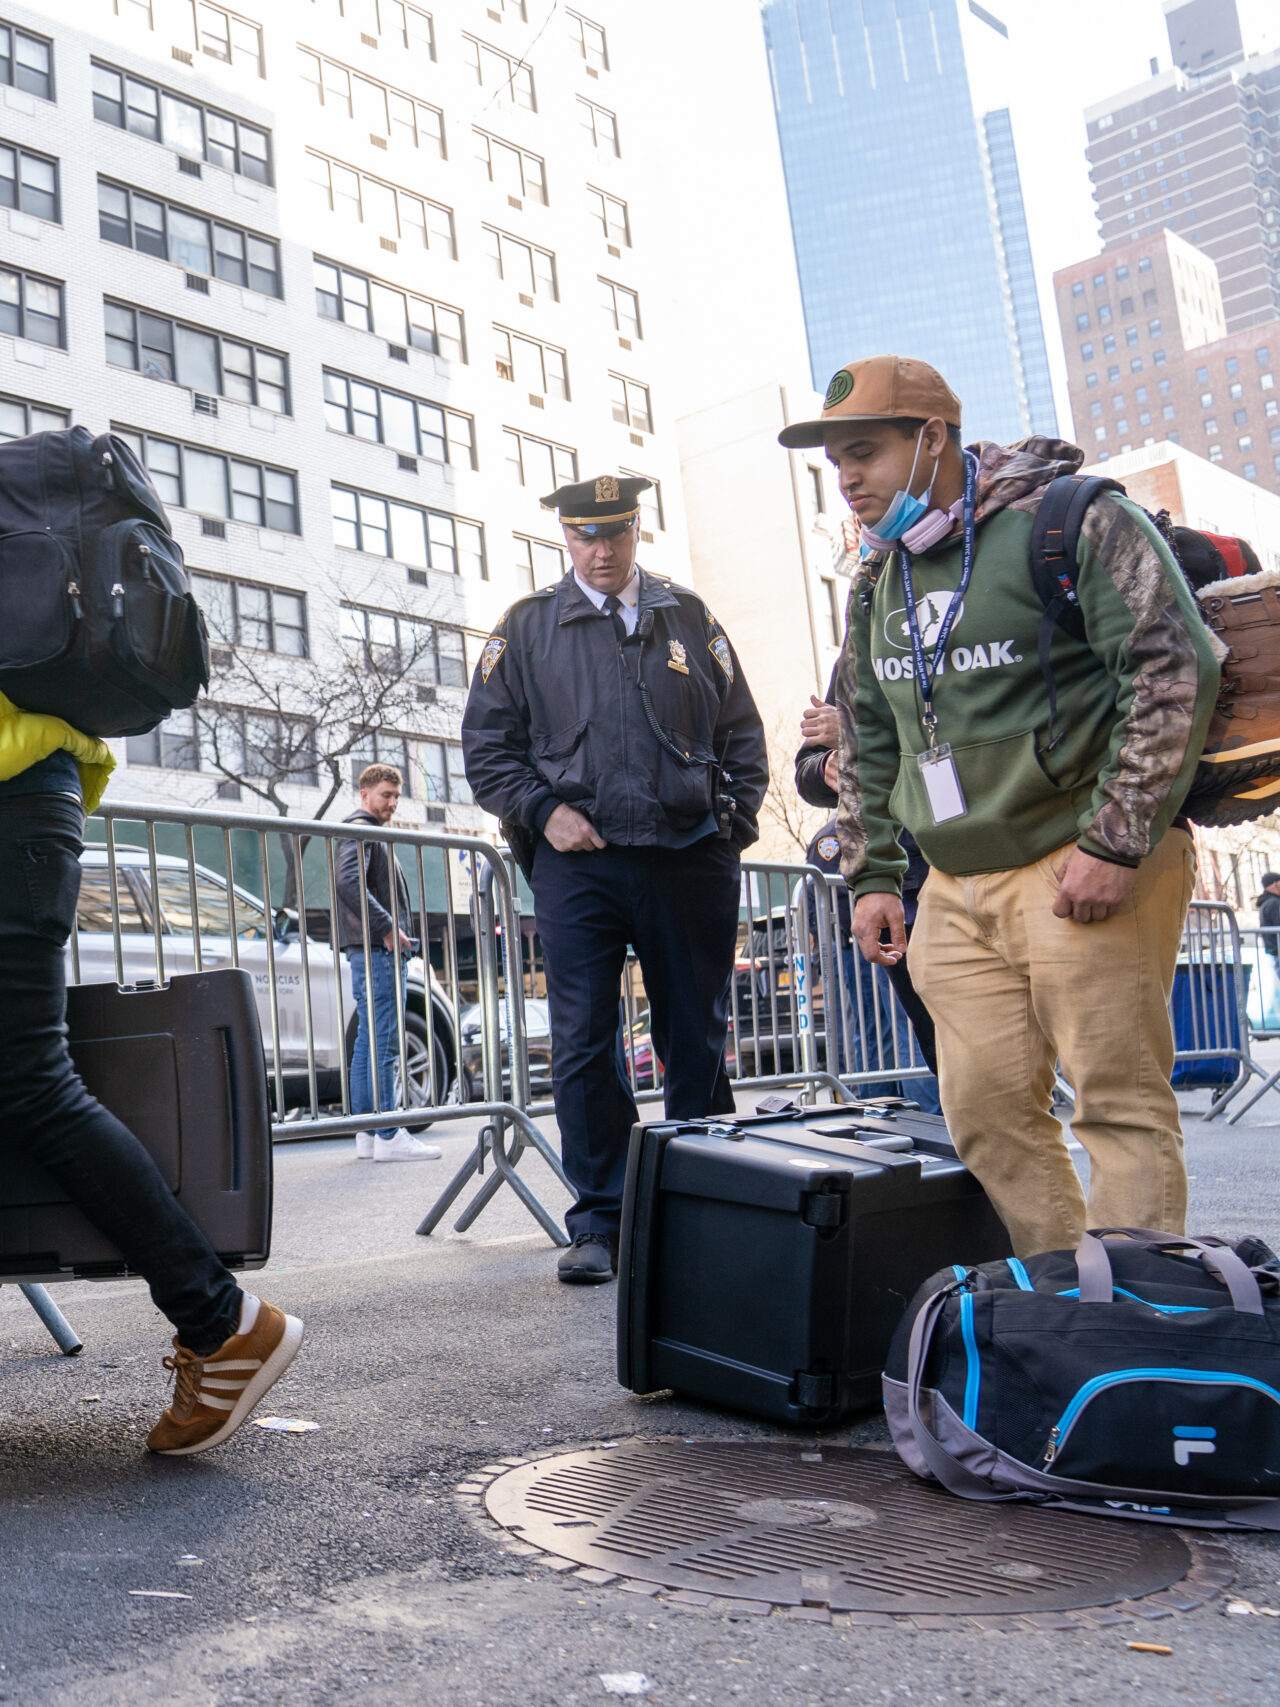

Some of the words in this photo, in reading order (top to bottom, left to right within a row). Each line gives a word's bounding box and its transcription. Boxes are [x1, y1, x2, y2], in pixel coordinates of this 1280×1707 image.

[940, 627, 949, 639] NYC
[912, 631, 920, 651] Champ!
[917, 661, 925, 673] NYC
[255, 975, 300, 986] NOICIAS
[795, 955, 809, 1030] NYPD
